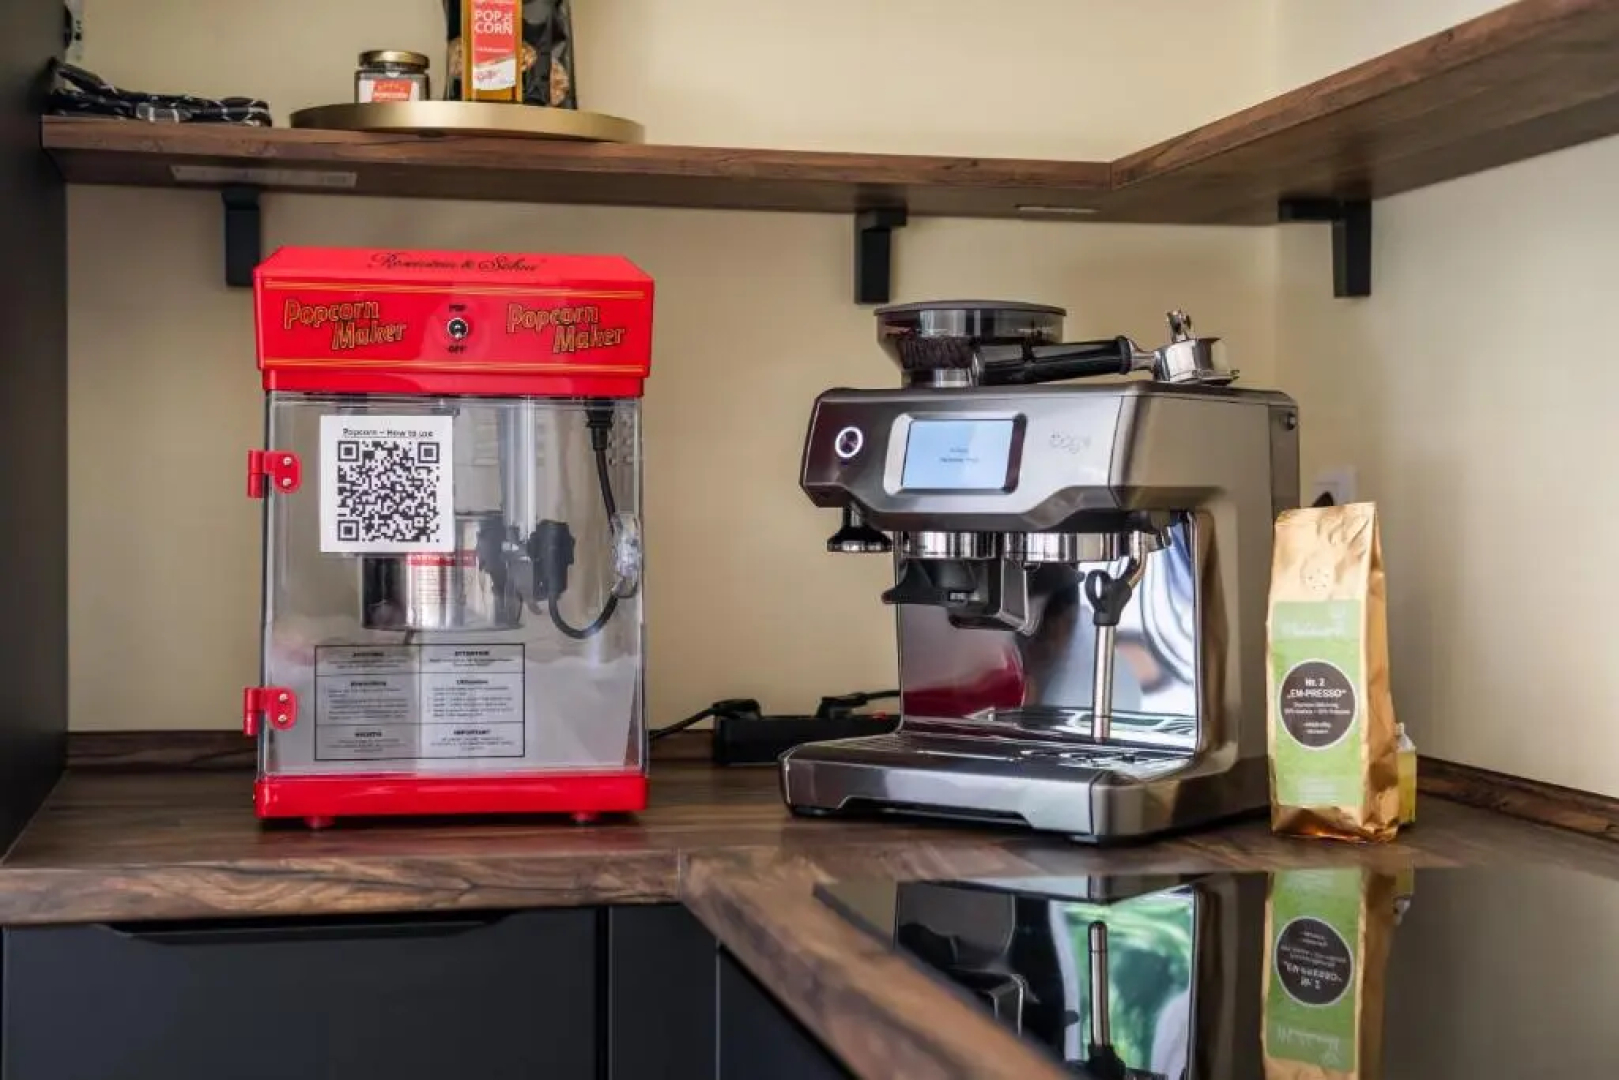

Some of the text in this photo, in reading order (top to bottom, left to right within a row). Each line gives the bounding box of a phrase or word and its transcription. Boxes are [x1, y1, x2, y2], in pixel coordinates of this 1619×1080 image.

[475, 10, 502, 21] POP
[475, 21, 513, 35] CORN
[284, 299, 380, 330] Popcorn
[506, 302, 600, 335] Popcorn
[331, 320, 407, 350] Maker
[553, 324, 625, 354] Maker
[343, 428, 378, 438] Popcorn
[1319, 678, 1325, 687] 2
